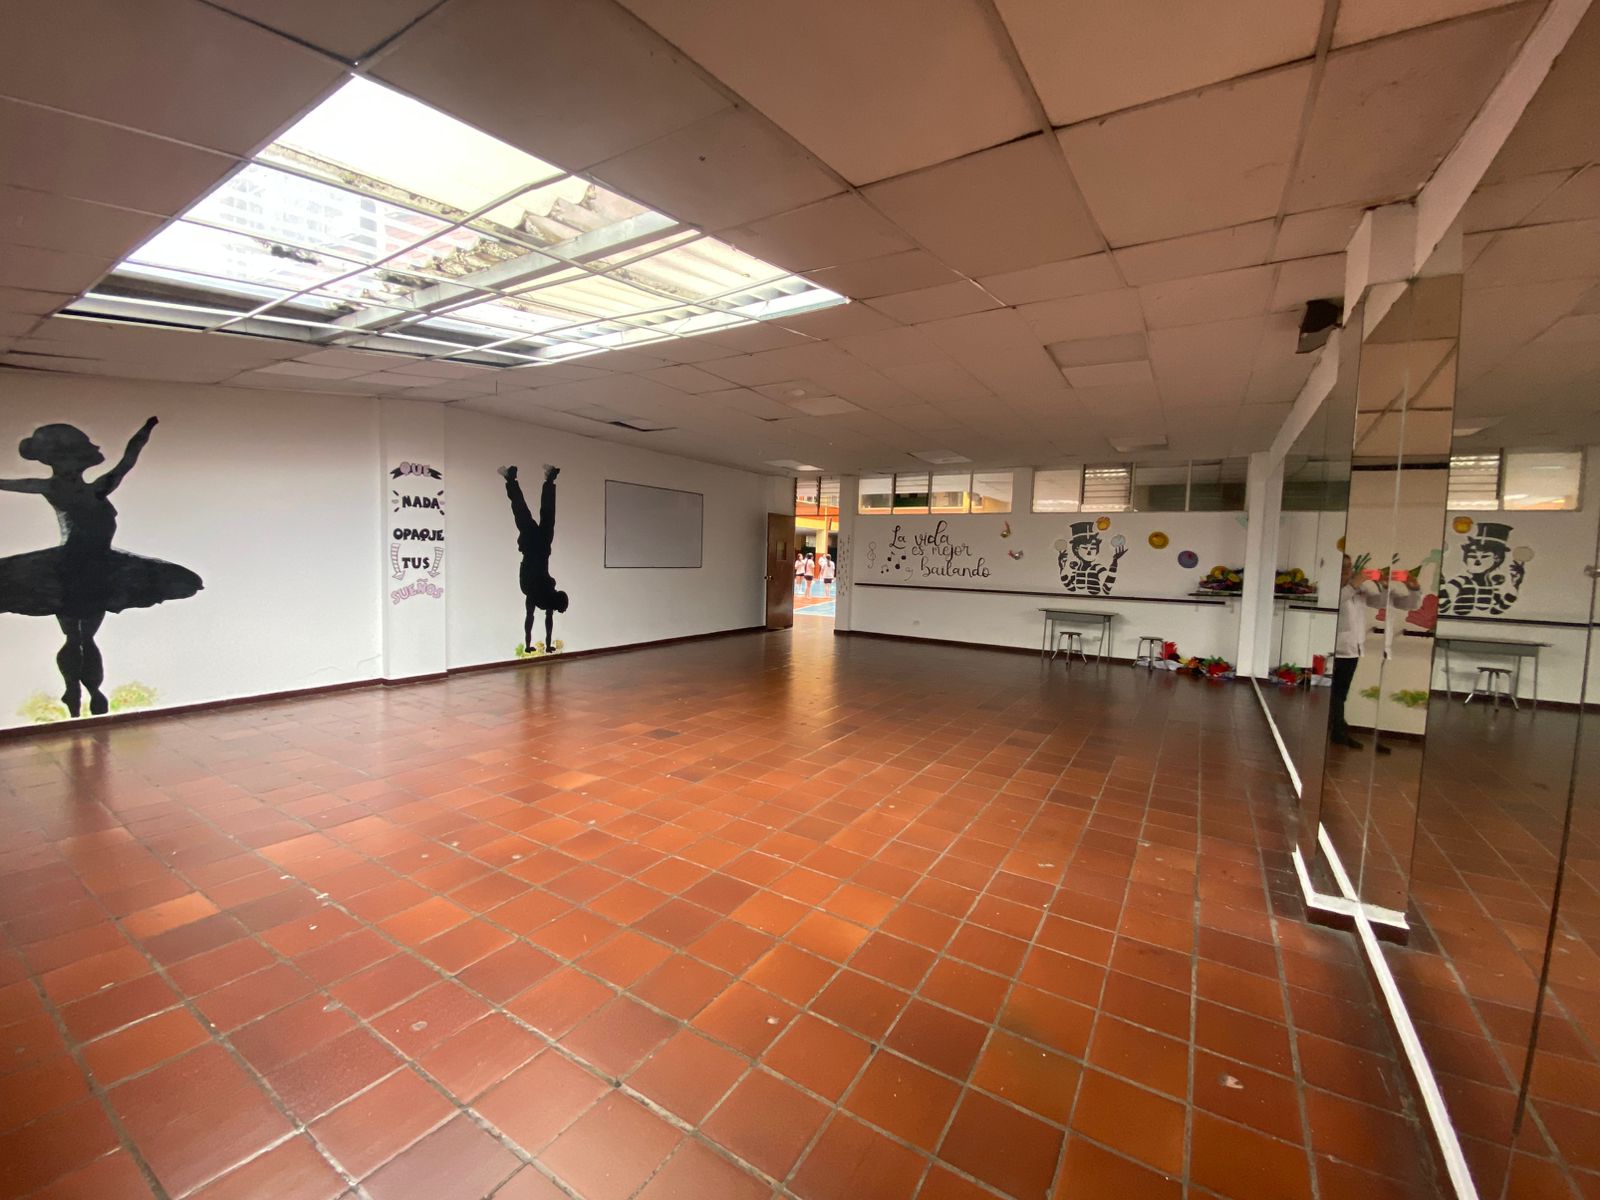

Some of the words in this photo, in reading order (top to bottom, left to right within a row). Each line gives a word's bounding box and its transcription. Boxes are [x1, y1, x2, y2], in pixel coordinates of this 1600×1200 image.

[400, 461, 431, 476] QUE
[402, 495, 440, 510] NADA
[889, 525, 906, 550] La
[915, 520, 951, 547] vida
[911, 546, 925, 556] es
[932, 543, 971, 560] mejor
[402, 556, 430, 570] TUS
[391, 578, 444, 605] SUEÑOS
